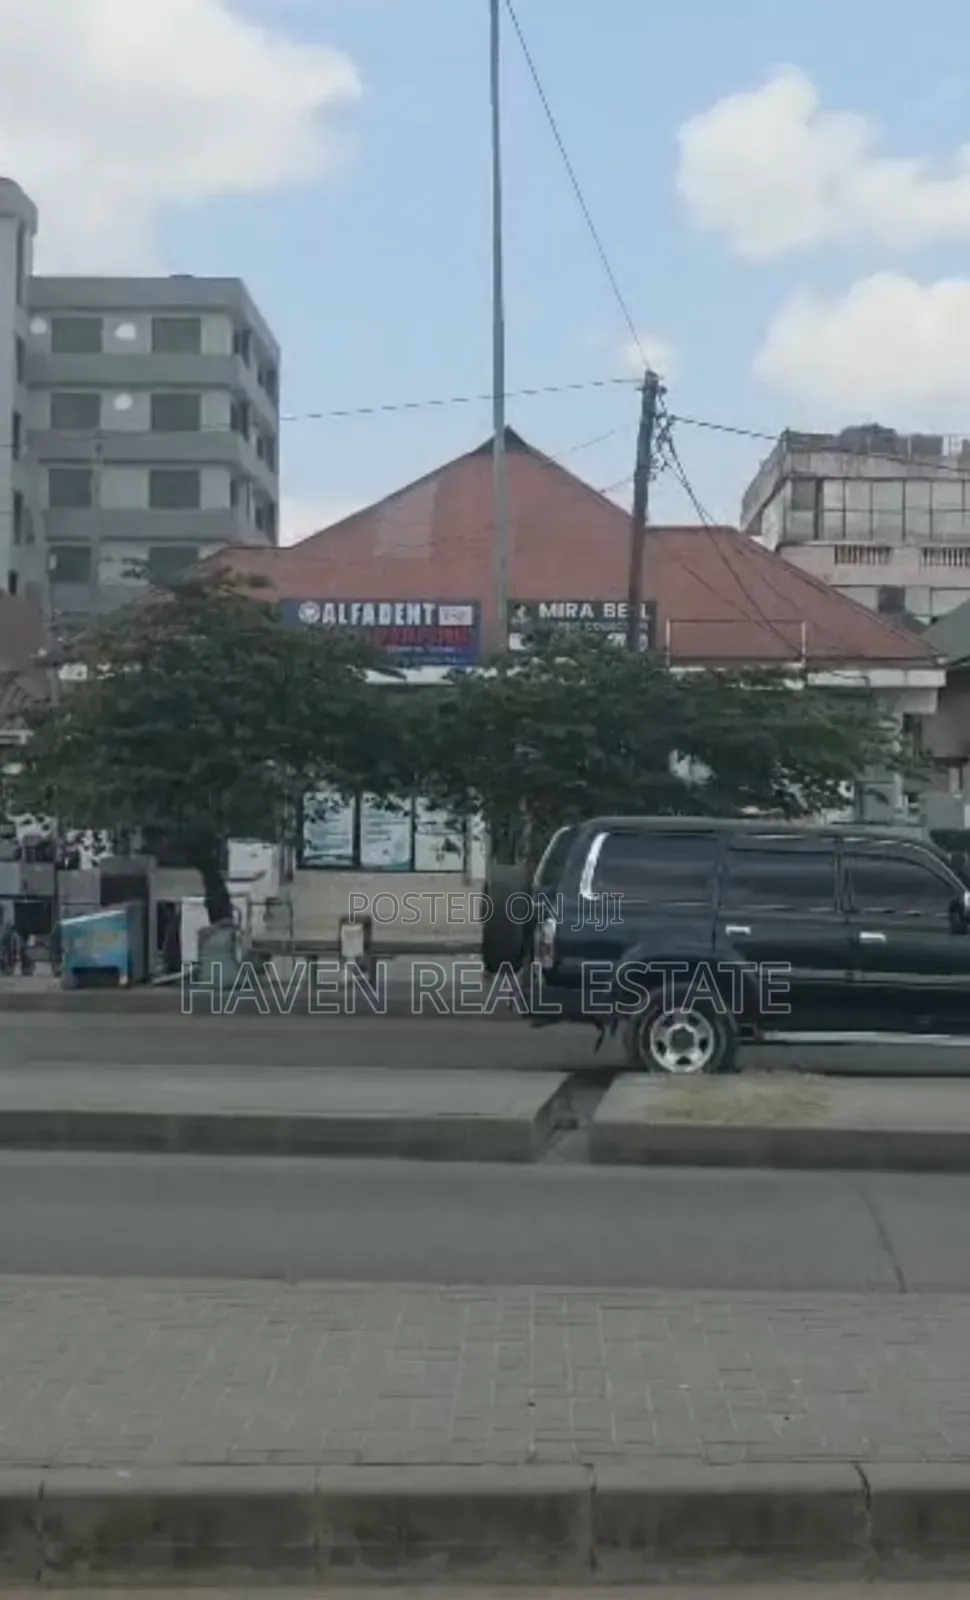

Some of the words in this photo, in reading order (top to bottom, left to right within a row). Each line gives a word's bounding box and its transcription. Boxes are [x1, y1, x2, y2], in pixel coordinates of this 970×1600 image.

[322, 603, 436, 626] ALFADENT
[538, 602, 594, 618] MIRA
[603, 602, 651, 619] BEL
